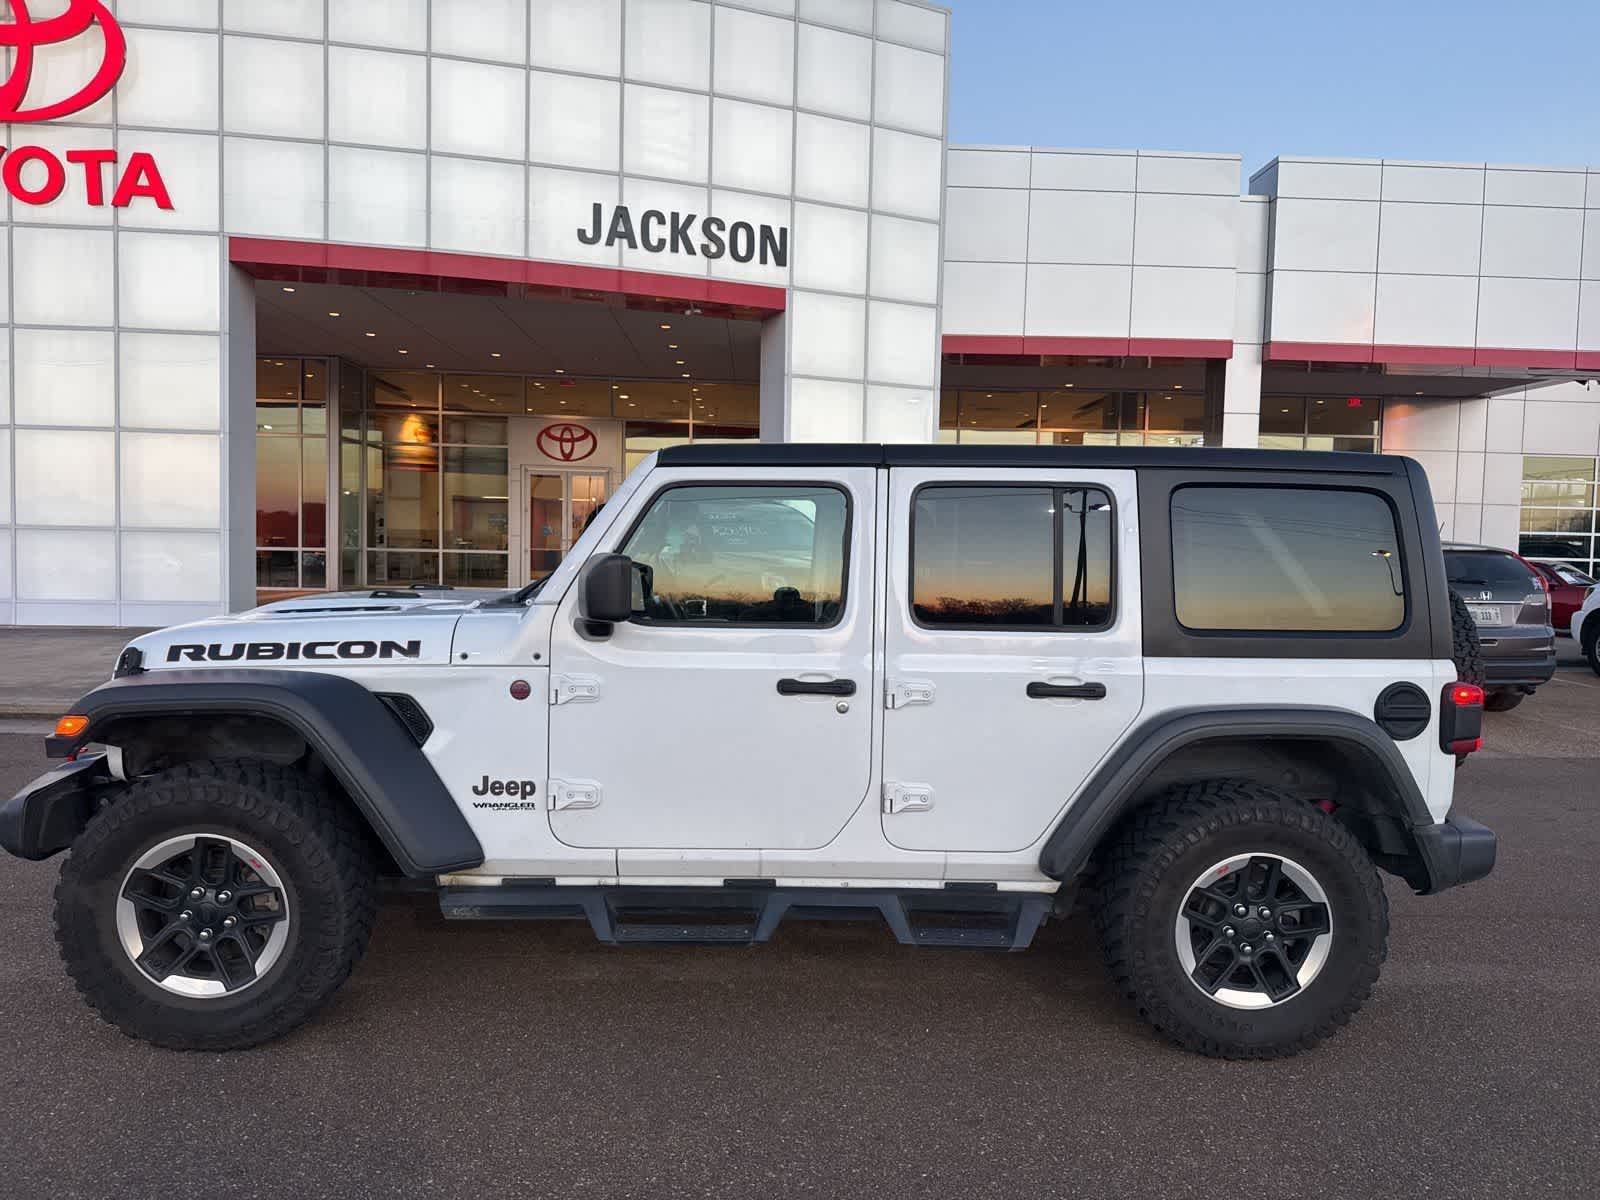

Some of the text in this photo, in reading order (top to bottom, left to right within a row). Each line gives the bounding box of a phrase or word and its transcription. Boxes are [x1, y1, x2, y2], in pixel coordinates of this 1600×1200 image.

[0, 145, 175, 210] OTA
[577, 202, 788, 267] JACKSON
[166, 640, 421, 662] RUBICON
[472, 775, 536, 800] Jeep
